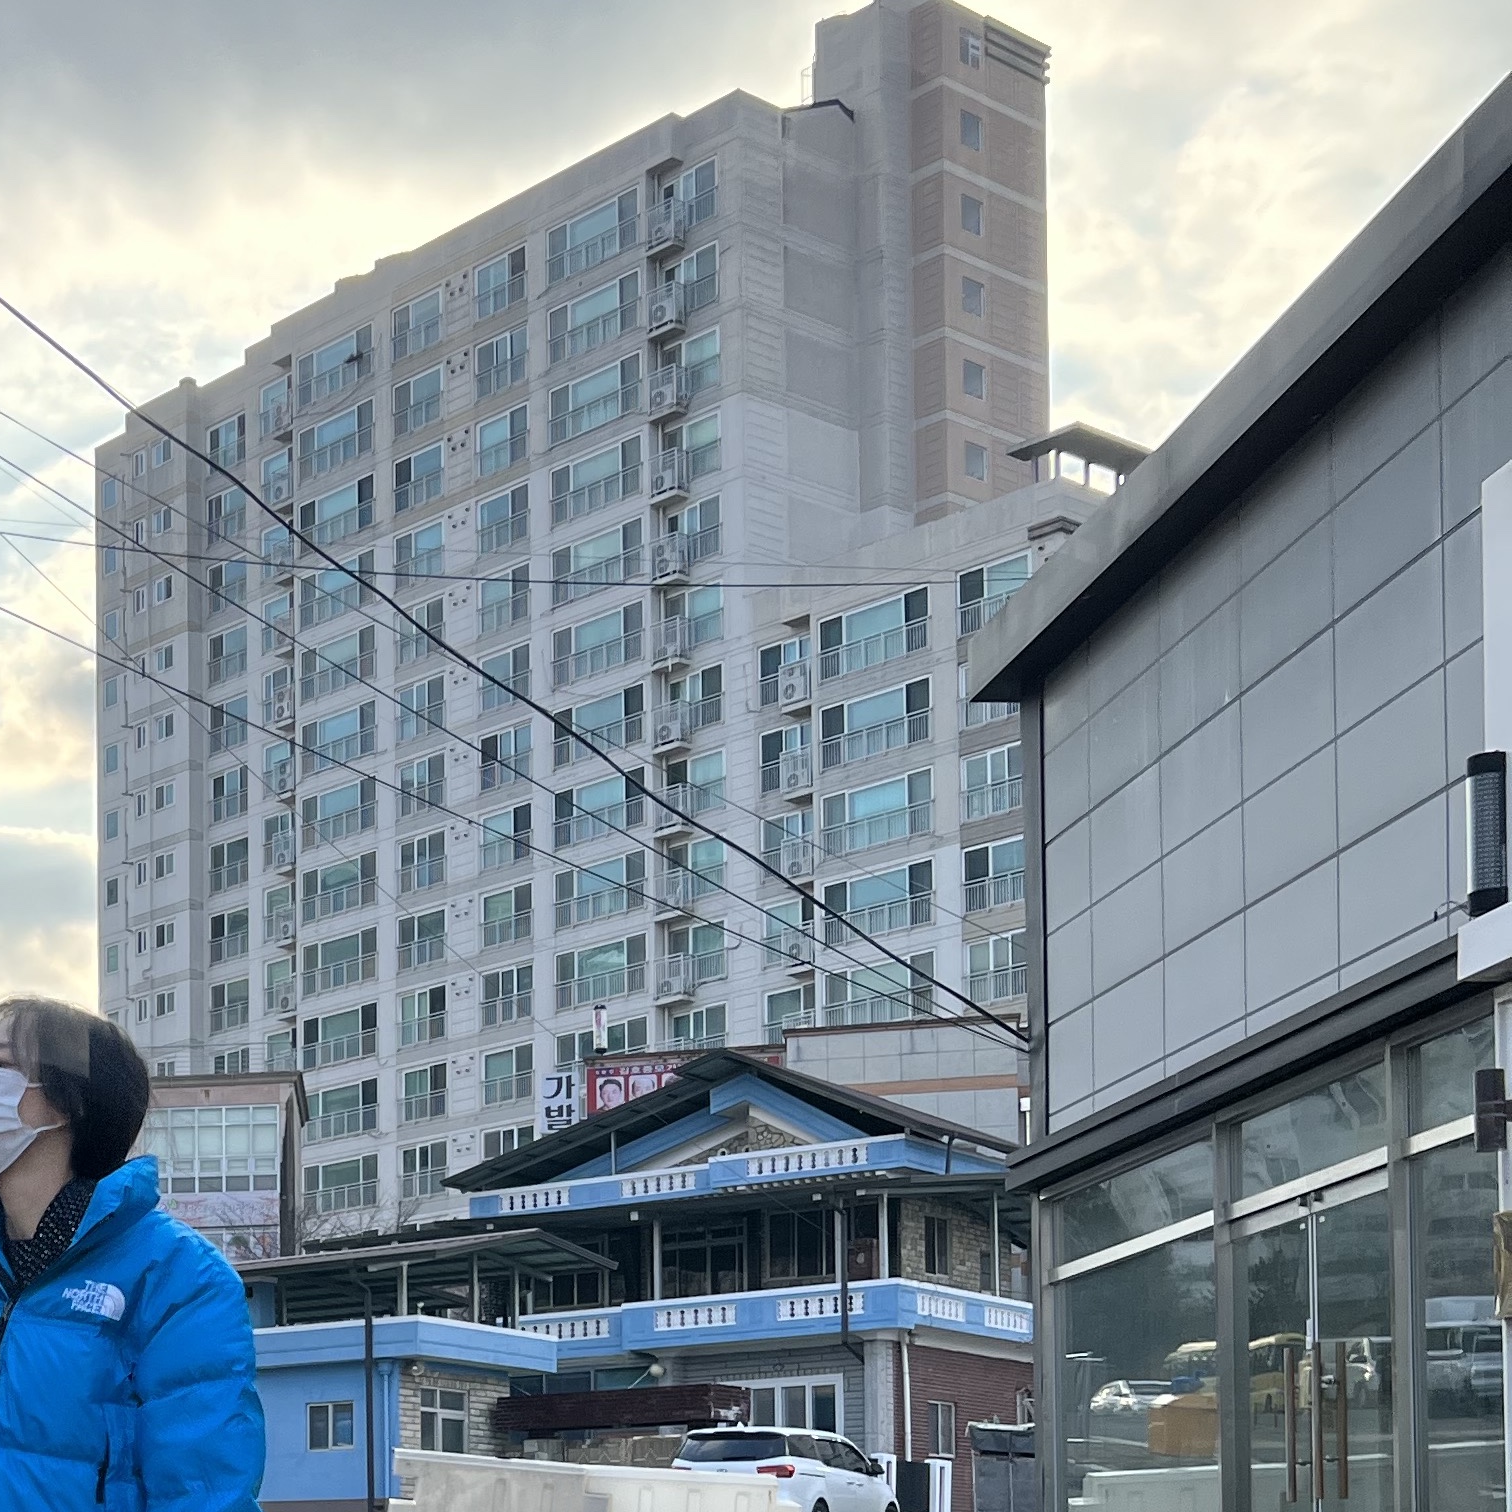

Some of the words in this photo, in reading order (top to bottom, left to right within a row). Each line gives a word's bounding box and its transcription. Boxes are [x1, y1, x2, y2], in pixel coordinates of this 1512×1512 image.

[542, 1074, 576, 1132] 가발
[85, 1280, 108, 1294] THE
[62, 1287, 105, 1305] NORTH
[71, 1300, 104, 1316] FACE
